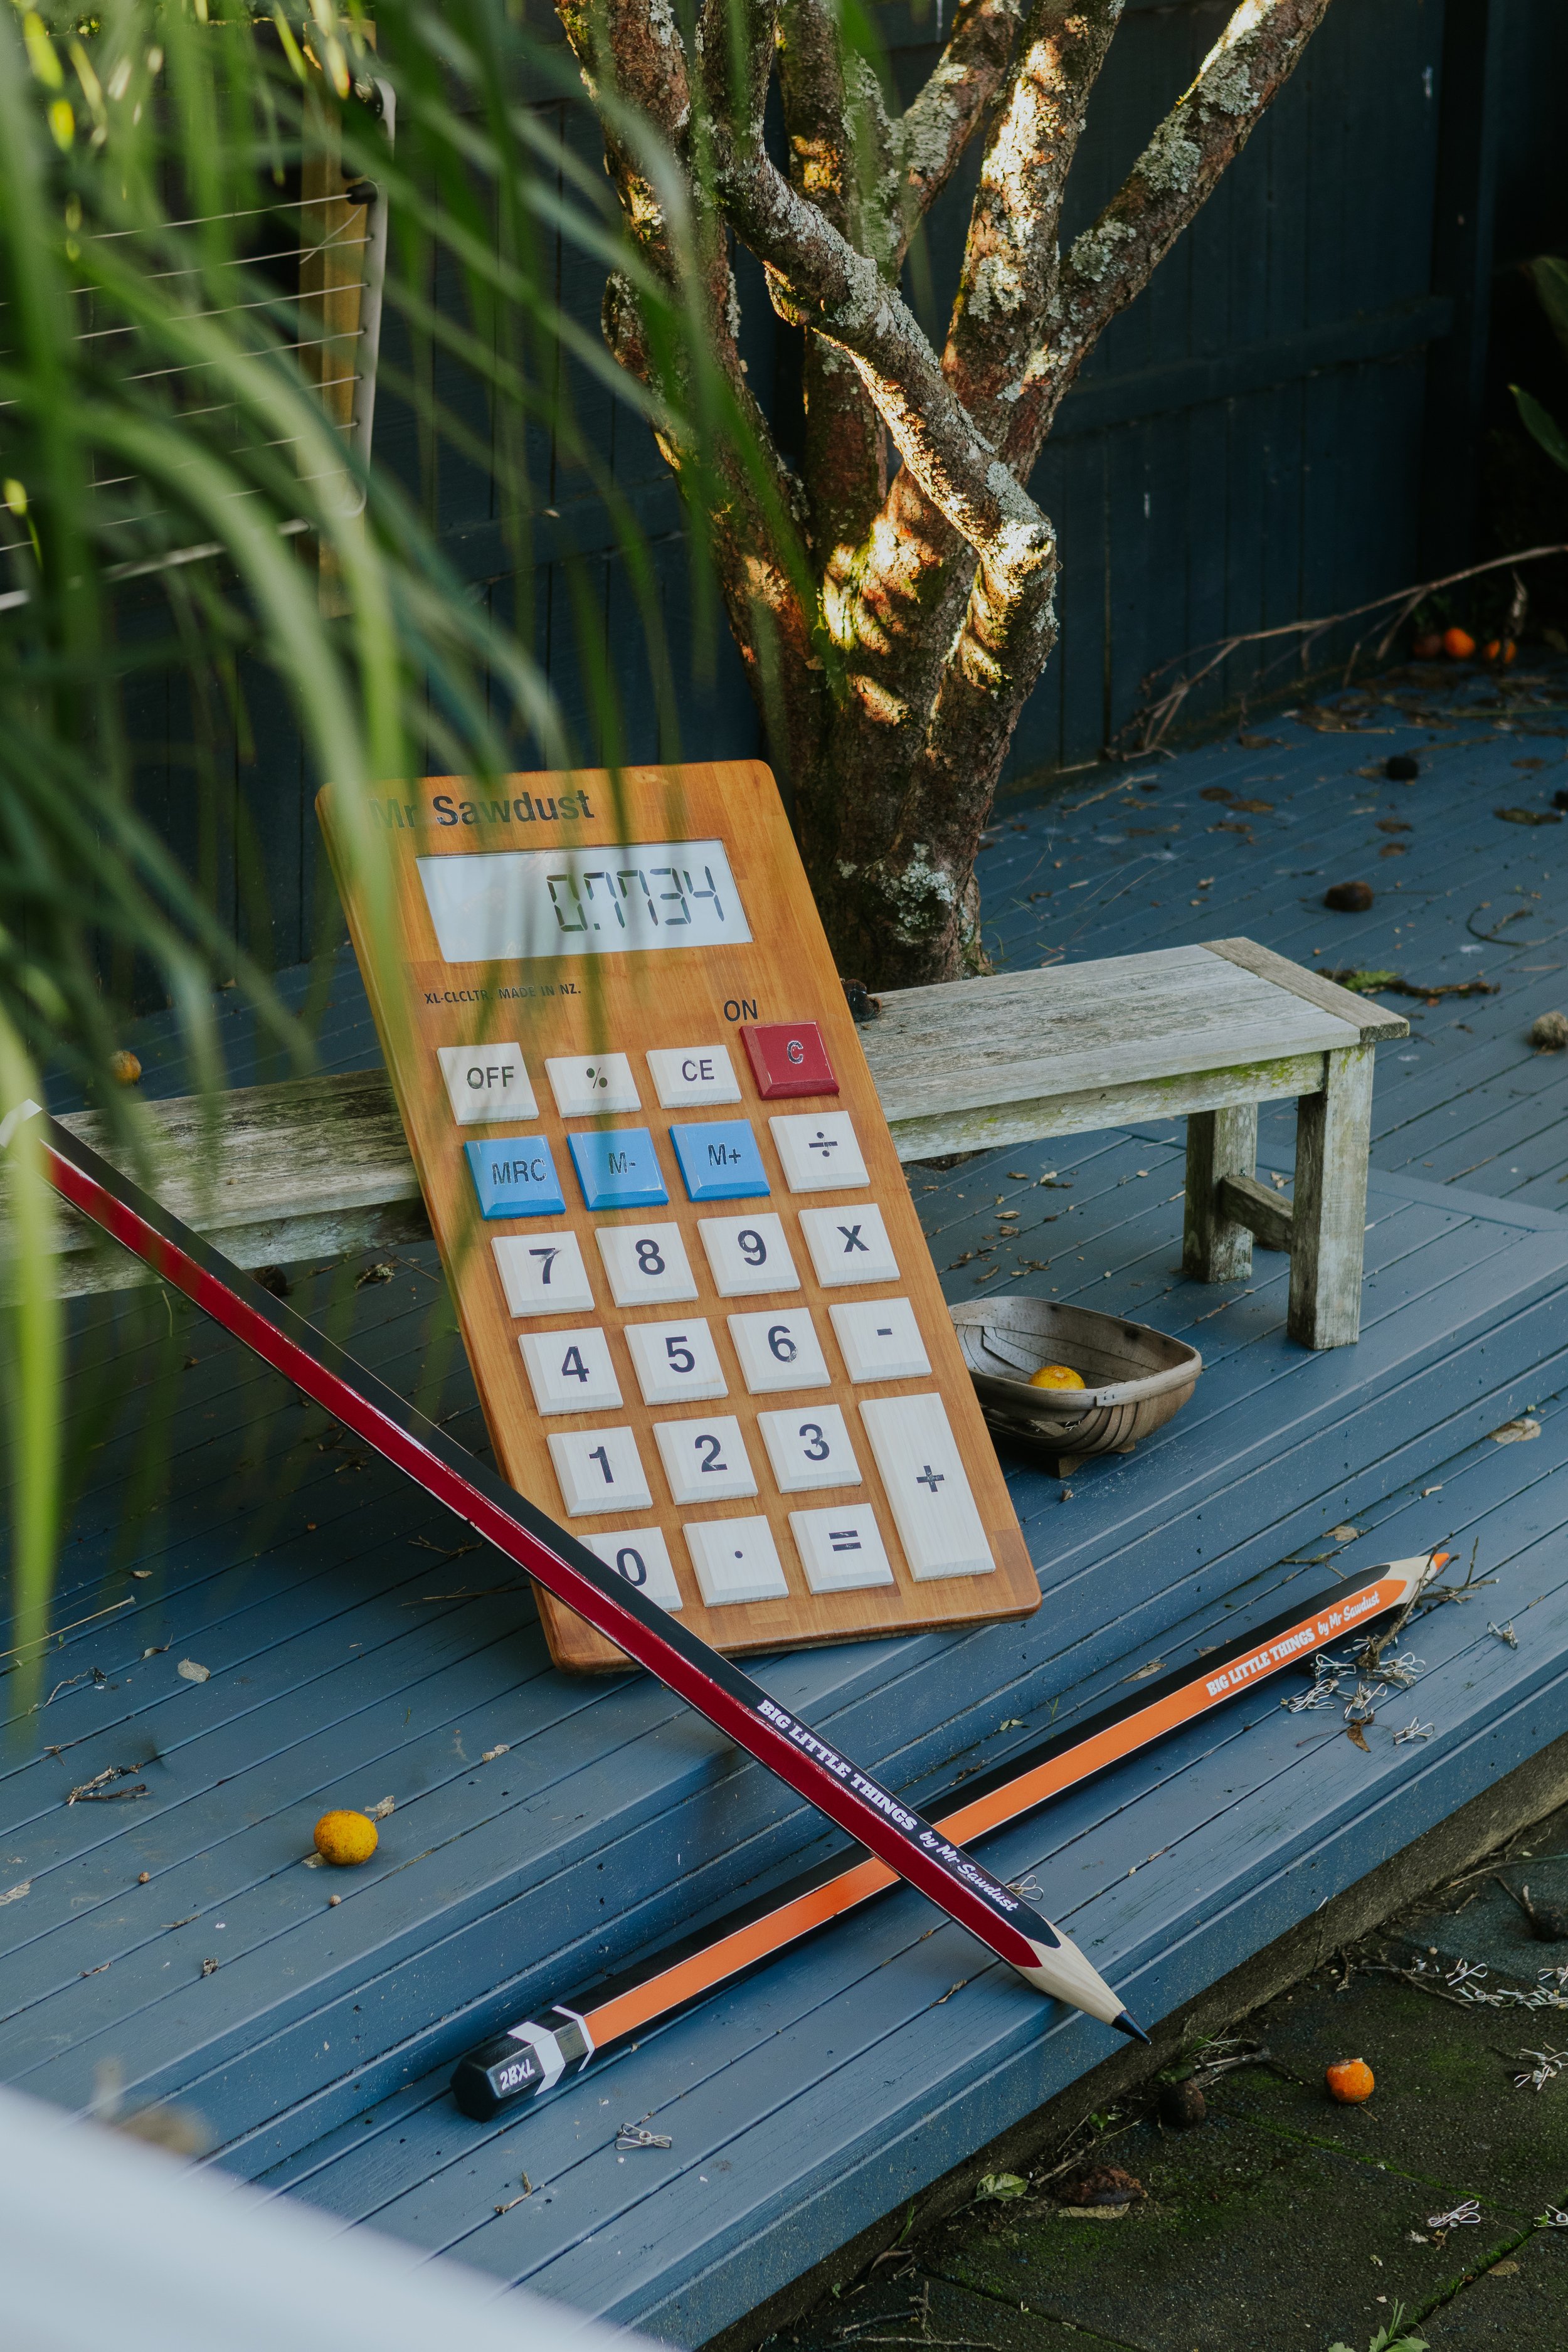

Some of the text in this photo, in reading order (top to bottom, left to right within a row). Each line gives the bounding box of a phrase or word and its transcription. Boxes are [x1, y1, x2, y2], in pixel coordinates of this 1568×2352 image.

[433, 790, 595, 827] Sawdust
[498, 985, 536, 999] MADE
[540, 983, 554, 996] IN
[559, 981, 581, 995] NZ.
[723, 999, 758, 1022] ON
[682, 1059, 714, 1082] CE
[787, 1040, 804, 1064] C
[467, 1066, 514, 1089] OFF
[492, 1158, 548, 1185] MRC
[608, 1151, 636, 1175] M-
[707, 1143, 741, 1167] M+
[637, 1239, 666, 1276] 8
[737, 1229, 766, 1266] 9
[529, 1248, 556, 1285] 7
[665, 1335, 695, 1373] 5
[768, 1325, 798, 1363] 6
[561, 1346, 590, 1383] 4
[694, 1434, 728, 1472] 2
[799, 1424, 830, 1461] 3
[589, 1446, 614, 1483] 1
[616, 1547, 647, 1587] 0
[1206, 1591, 1380, 1697] BIG LITTLE THINGS by Mr Sawdust
[758, 1700, 1019, 1911] BIG LITTLE THINGS by Mr Sawdust
[501, 2059, 534, 2090] 2BXL
